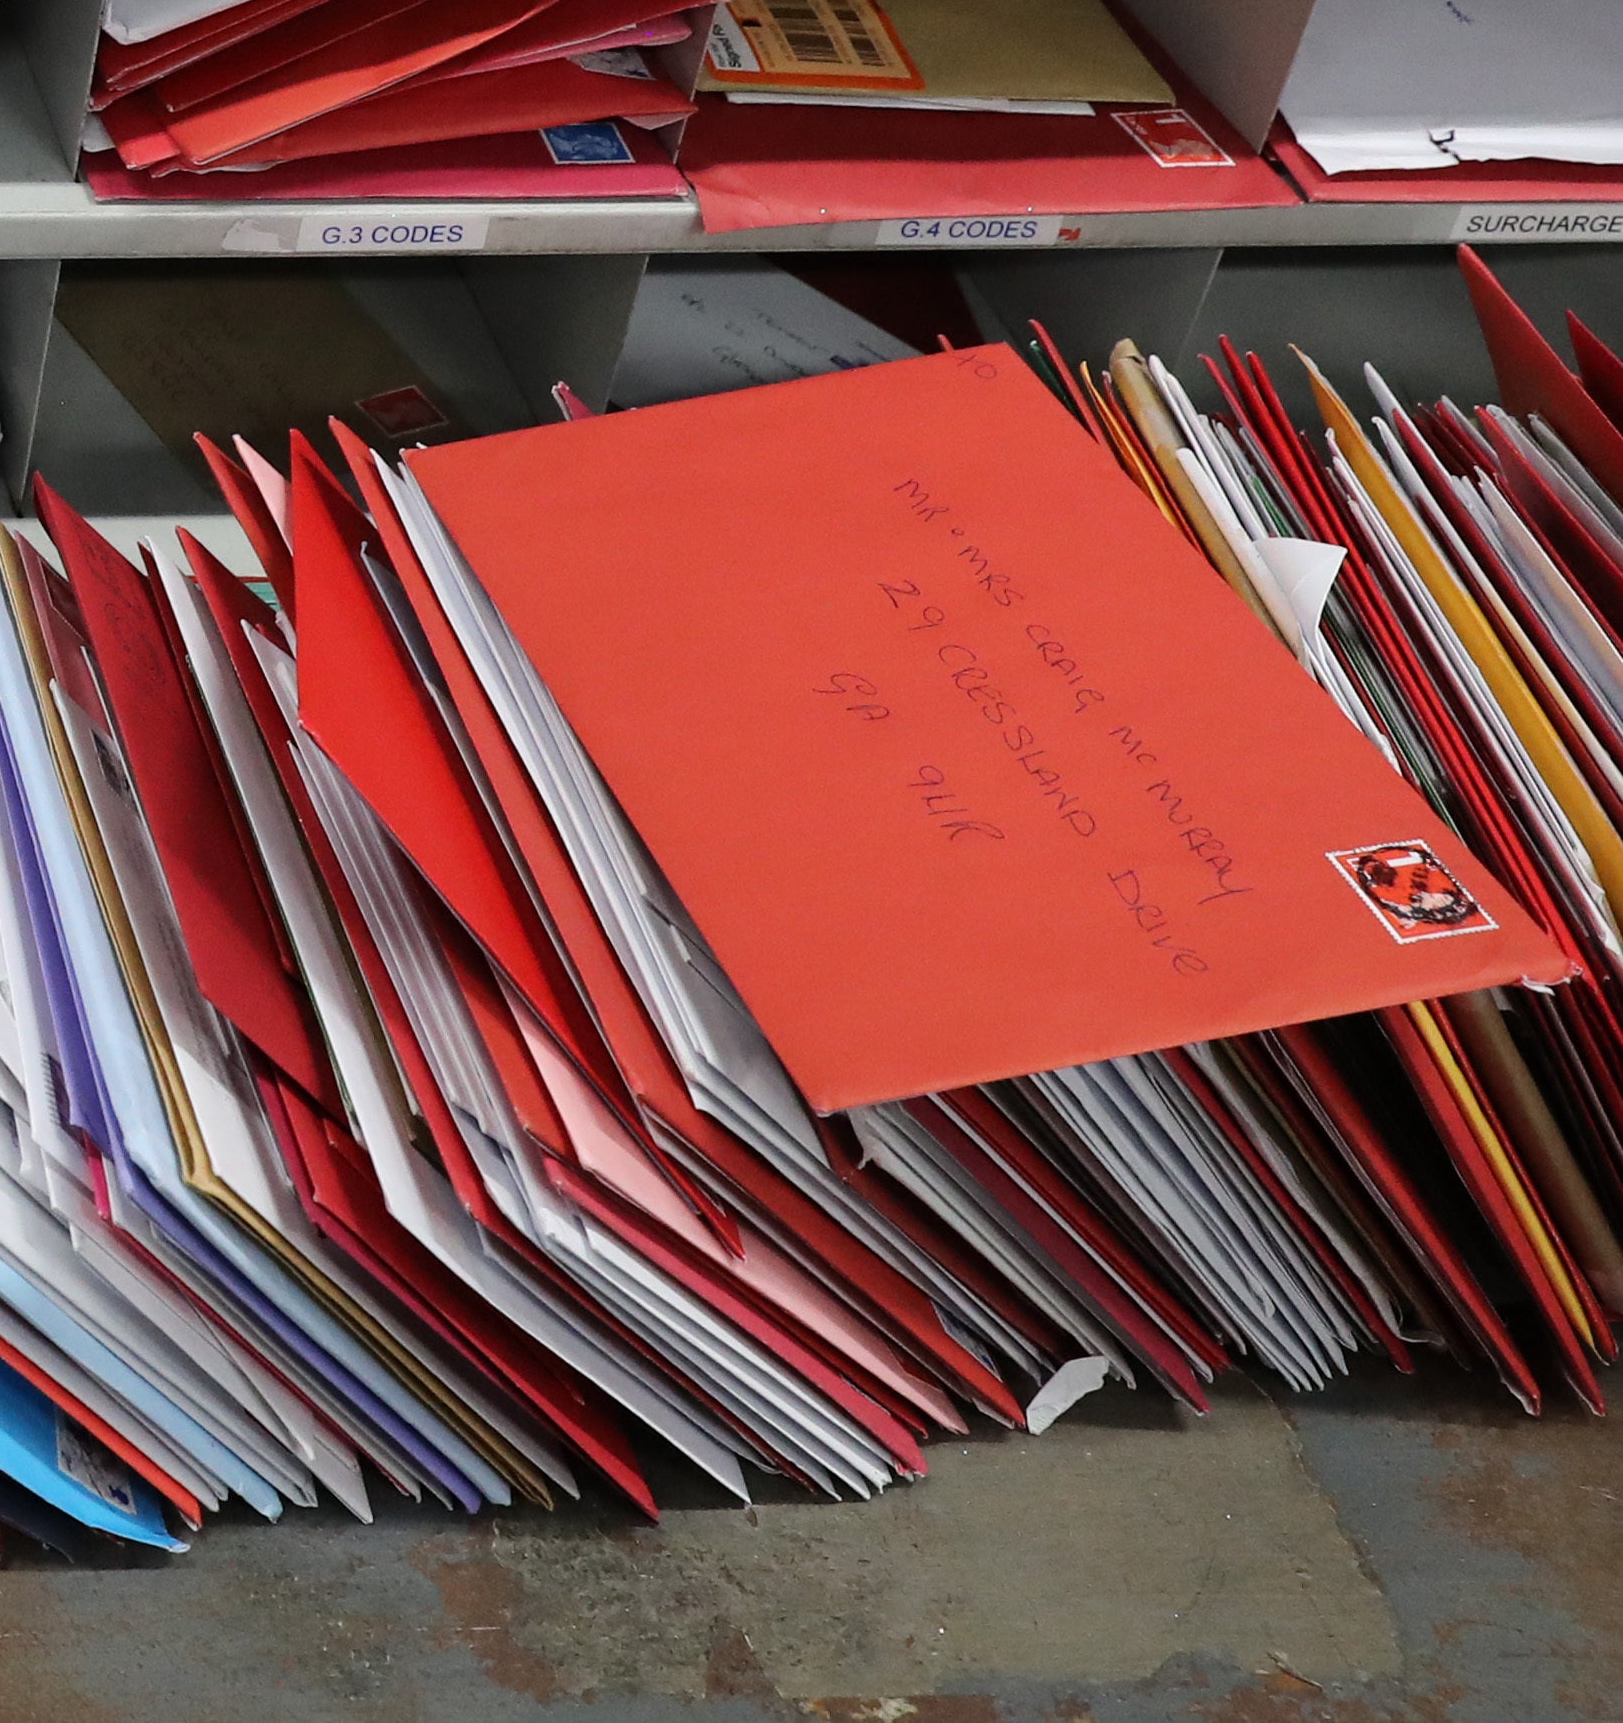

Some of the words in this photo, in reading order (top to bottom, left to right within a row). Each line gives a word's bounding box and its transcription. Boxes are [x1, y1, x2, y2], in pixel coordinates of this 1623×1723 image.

[900, 220, 941, 240] G.4
[947, 220, 1037, 239] CODES
[1466, 215, 1623, 233] SURCHARGE
[322, 226, 363, 245] G.3
[371, 225, 463, 244] CODES
